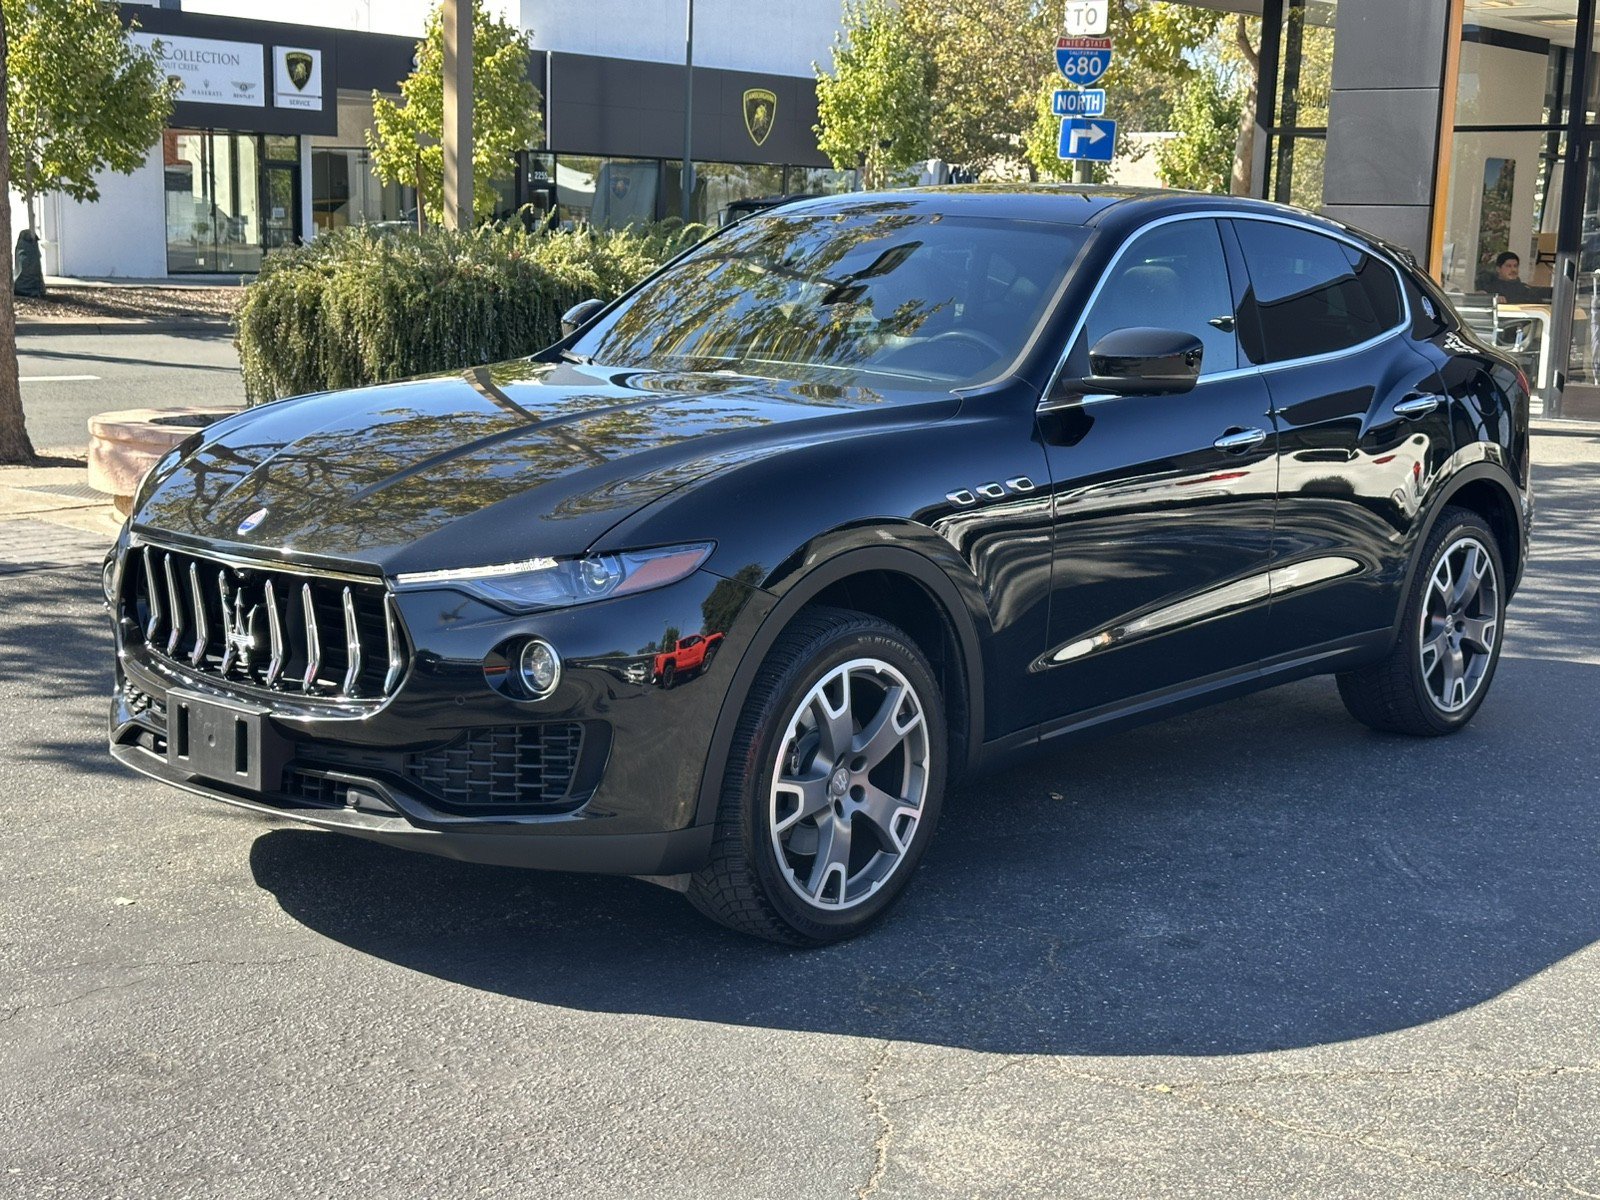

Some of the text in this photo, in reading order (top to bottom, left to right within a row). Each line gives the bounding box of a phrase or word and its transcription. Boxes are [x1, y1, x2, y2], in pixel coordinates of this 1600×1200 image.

[1074, 8, 1097, 26] TO
[1061, 40, 1107, 48] INTERSTATE
[178, 63, 200, 72] CREEK
[1064, 56, 1102, 76] 680
[191, 89, 223, 97] MASERATI
[289, 99, 311, 107] SERVICE
[1056, 94, 1101, 111] NORTH
[534, 171, 548, 180] 2255
